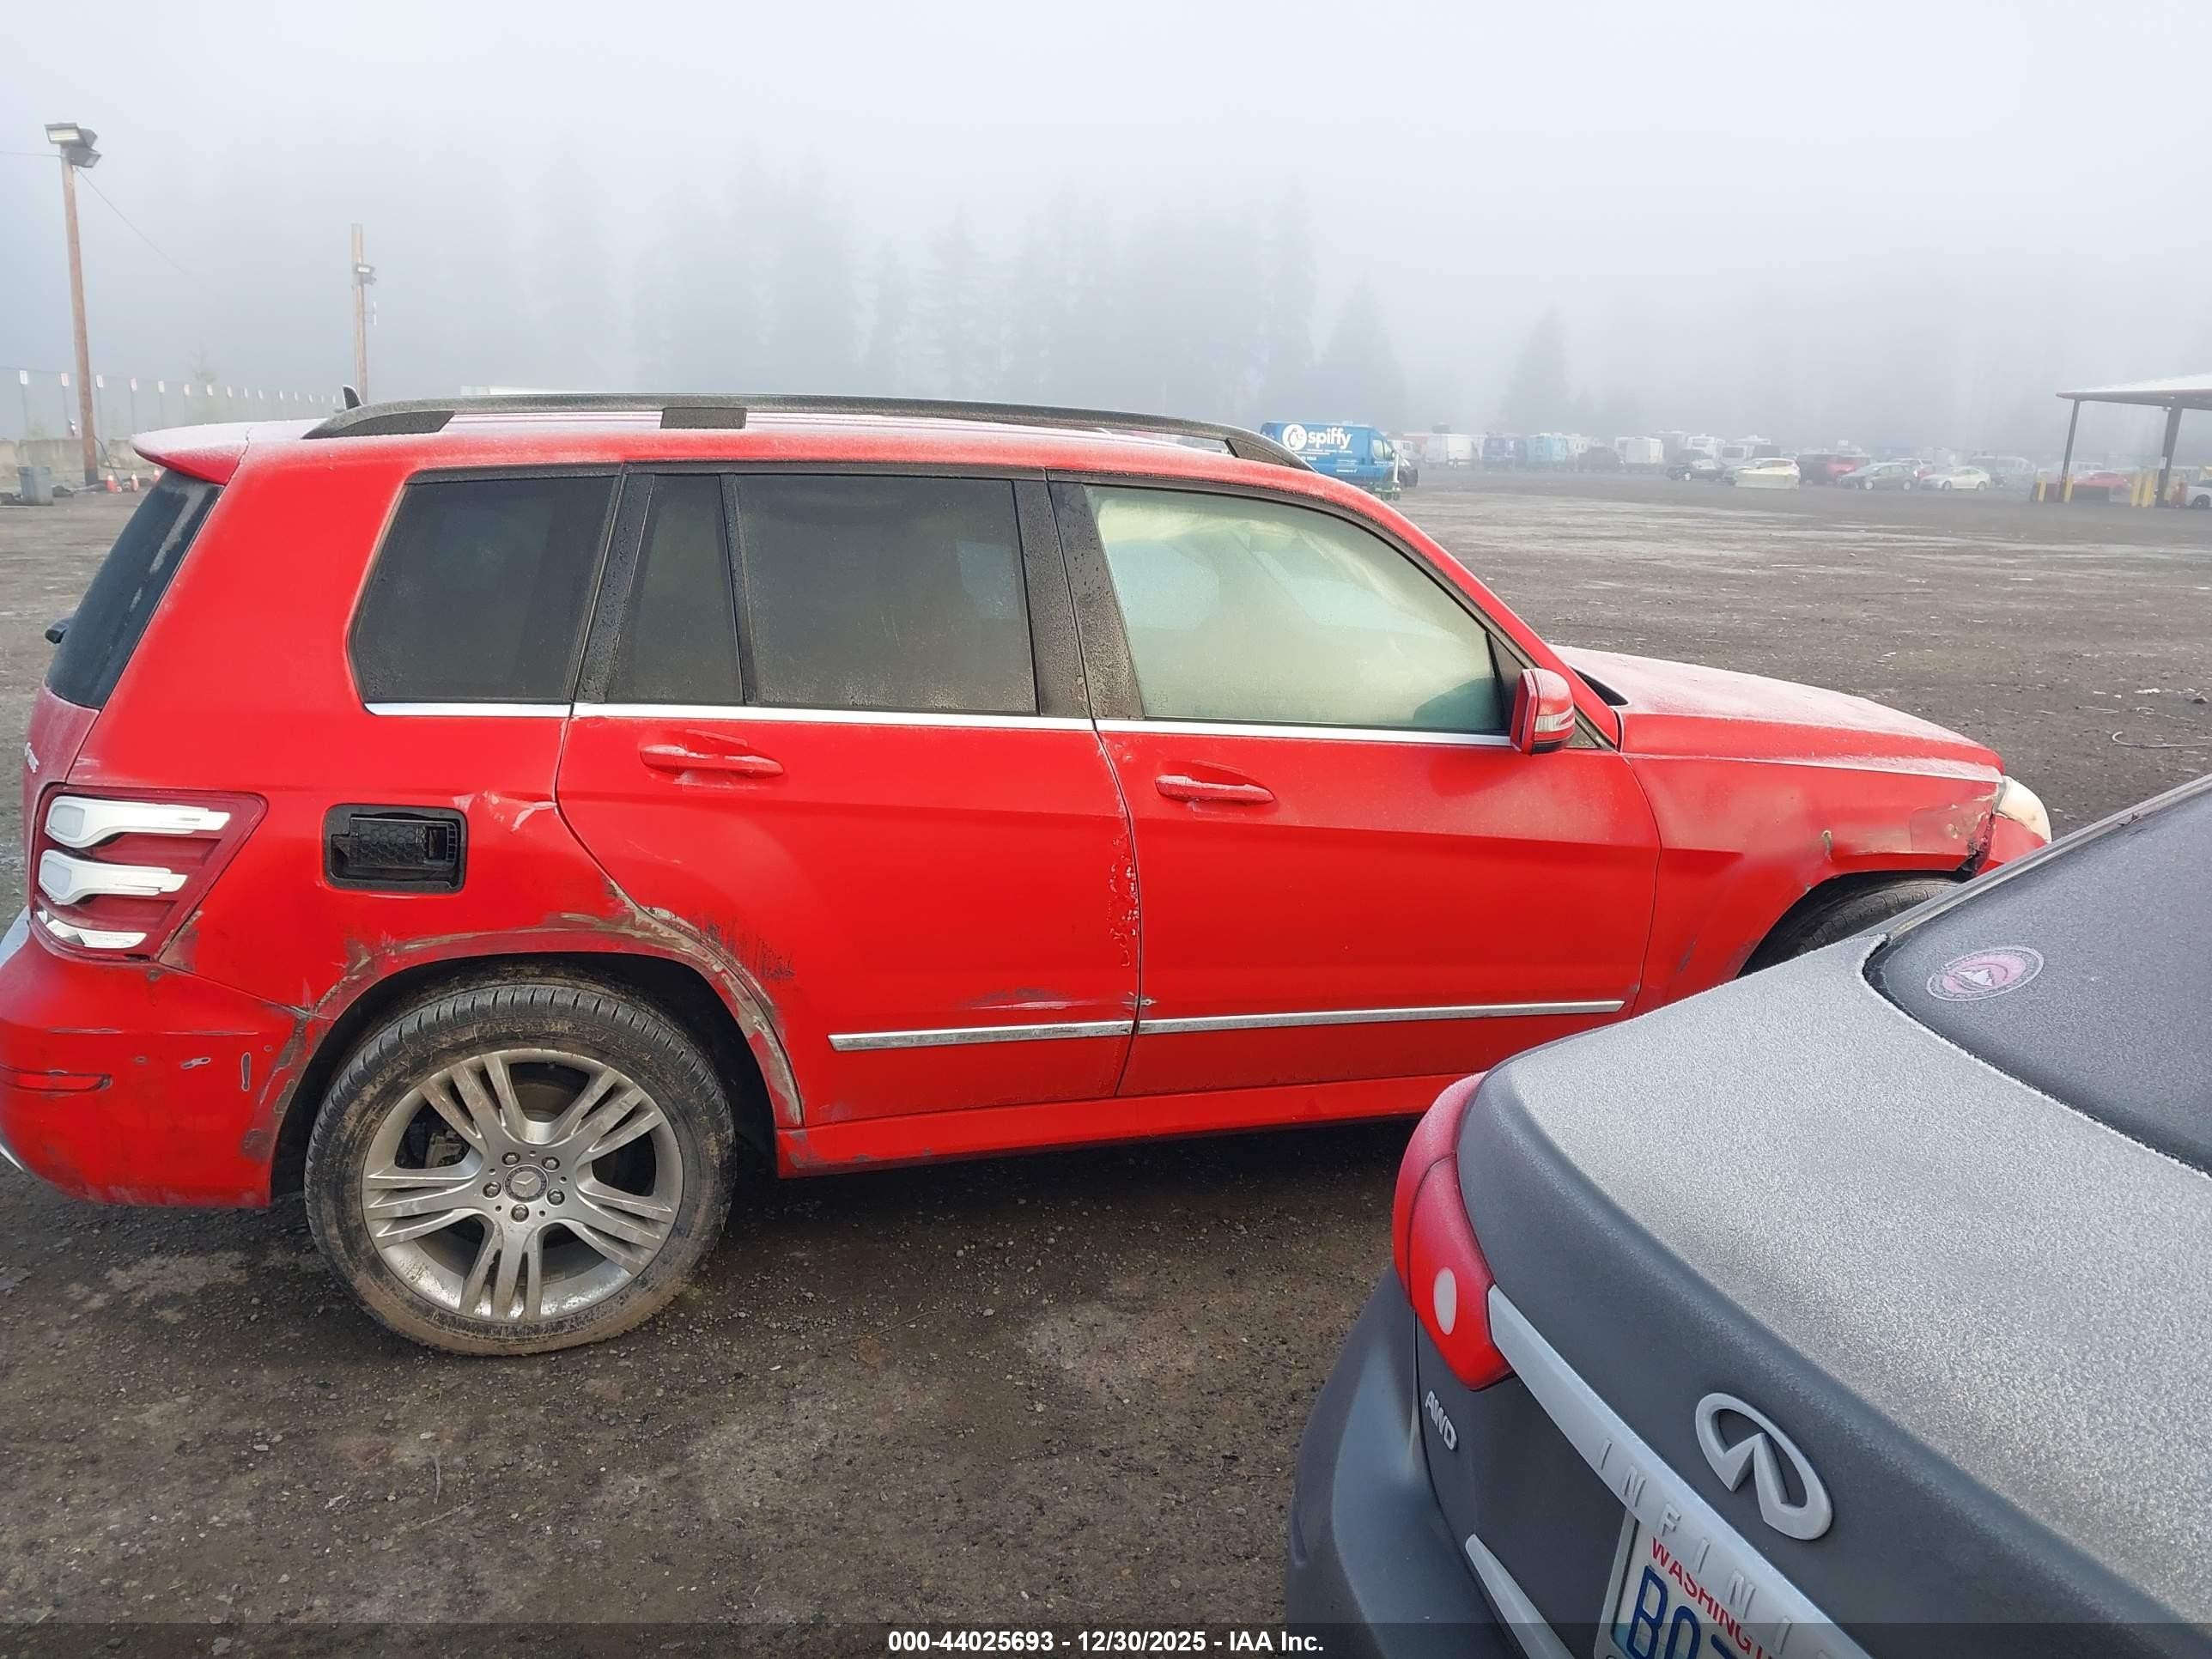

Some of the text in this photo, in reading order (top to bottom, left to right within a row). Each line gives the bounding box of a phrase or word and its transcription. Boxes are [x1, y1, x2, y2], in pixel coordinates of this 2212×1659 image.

[1308, 427, 1352, 449] spiffy
[1425, 1390, 1457, 1450] AWD
[1600, 1437, 1827, 1659] INFINI
[1652, 1536, 1773, 1659] WASHING
